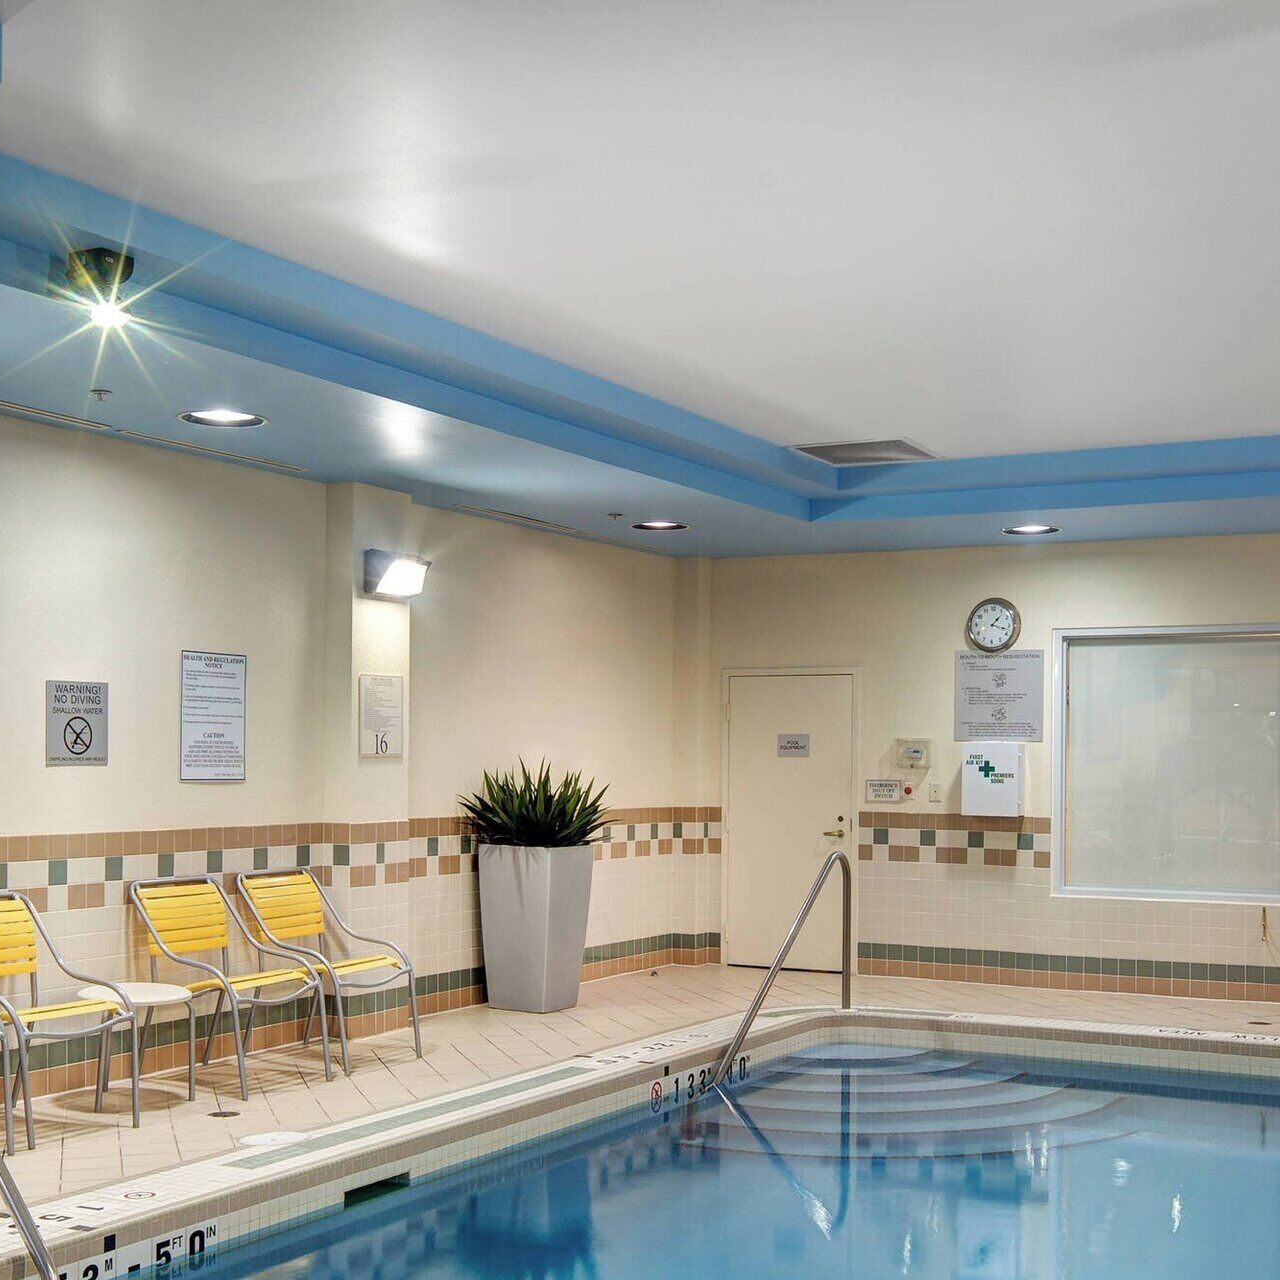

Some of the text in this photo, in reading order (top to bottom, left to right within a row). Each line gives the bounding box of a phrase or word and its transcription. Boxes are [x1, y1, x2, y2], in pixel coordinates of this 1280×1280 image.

[55, 684, 102, 695] WARNING!
[54, 695, 101, 705] NO DIVING
[52, 706, 81, 714] SHALLOW
[375, 733, 388, 754] 16
